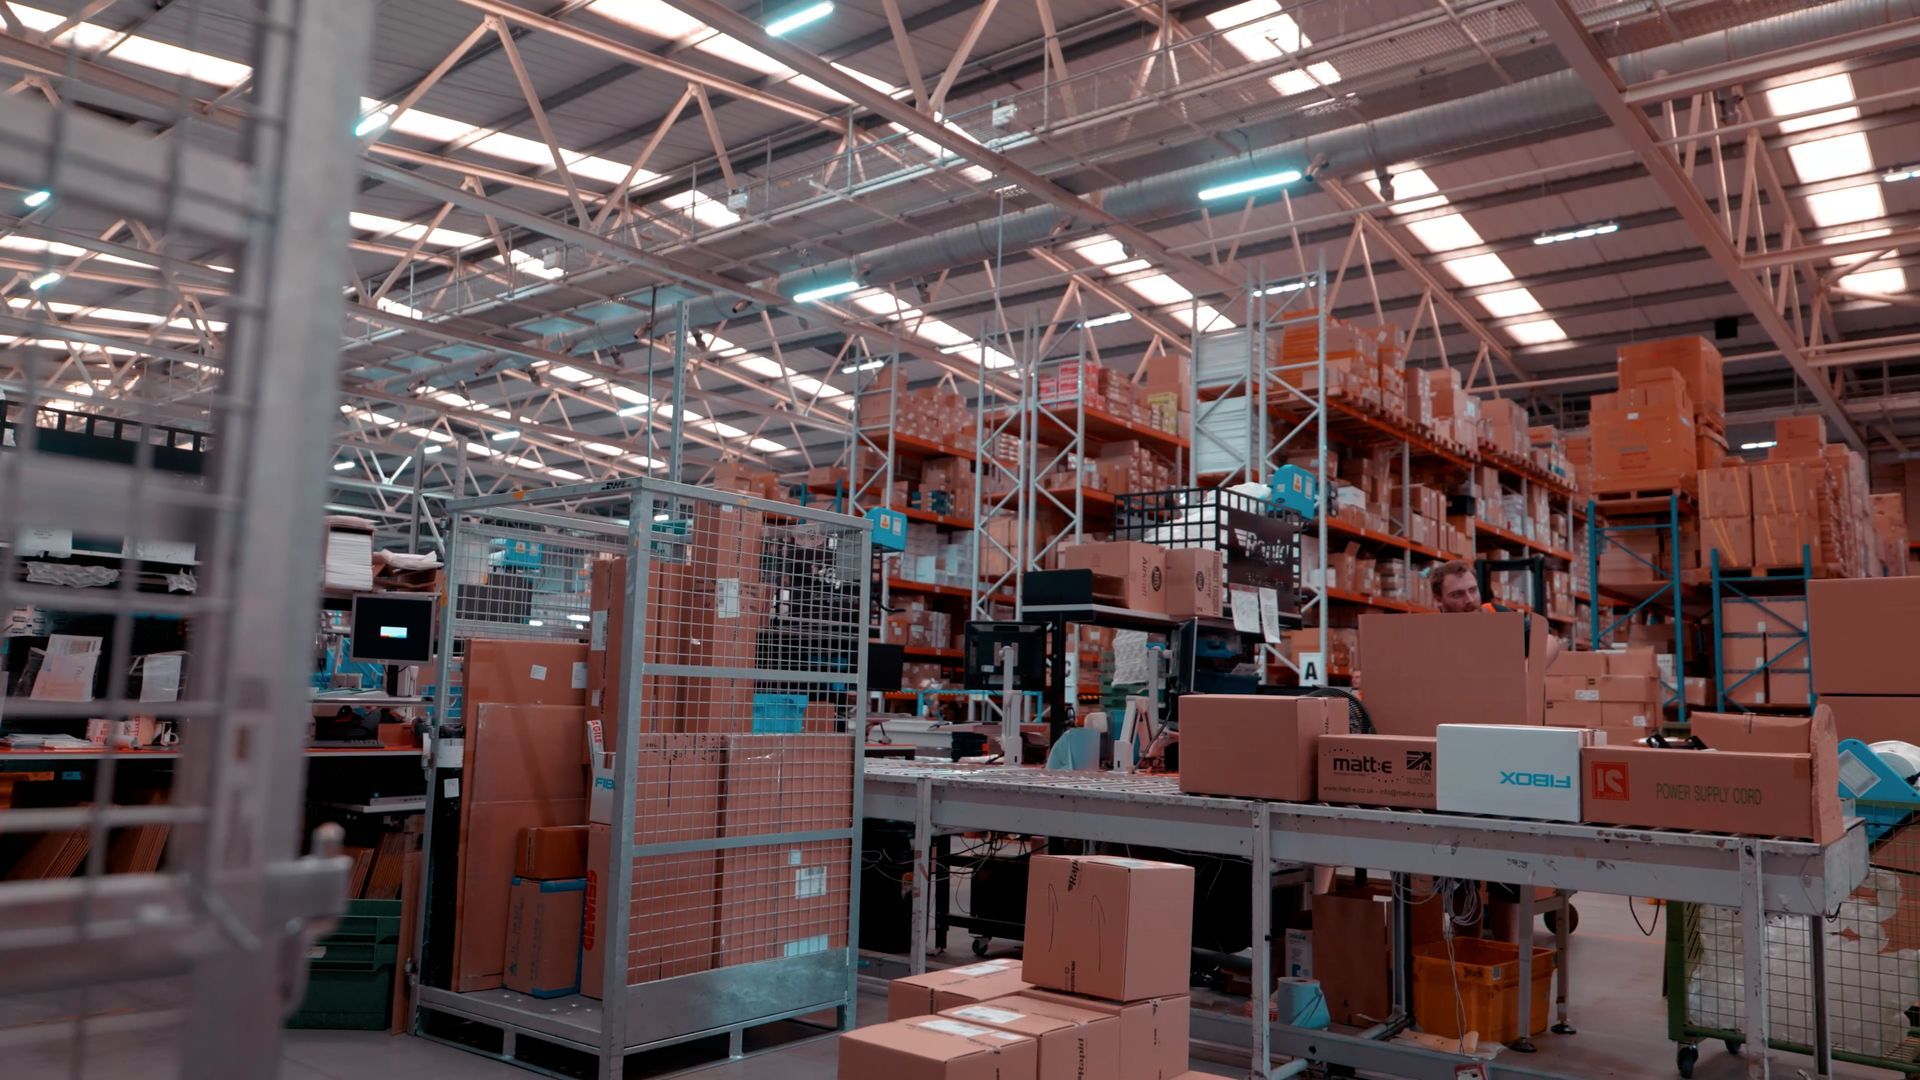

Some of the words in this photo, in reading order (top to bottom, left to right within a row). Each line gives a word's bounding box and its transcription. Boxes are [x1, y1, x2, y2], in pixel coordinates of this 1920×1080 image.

[1304, 661, 1318, 681] A
[1499, 771, 1571, 788] FIBOX
[1656, 783, 1690, 800] POWER
[1694, 785, 1729, 803] SUPPLY
[1733, 787, 1762, 805] CORD
